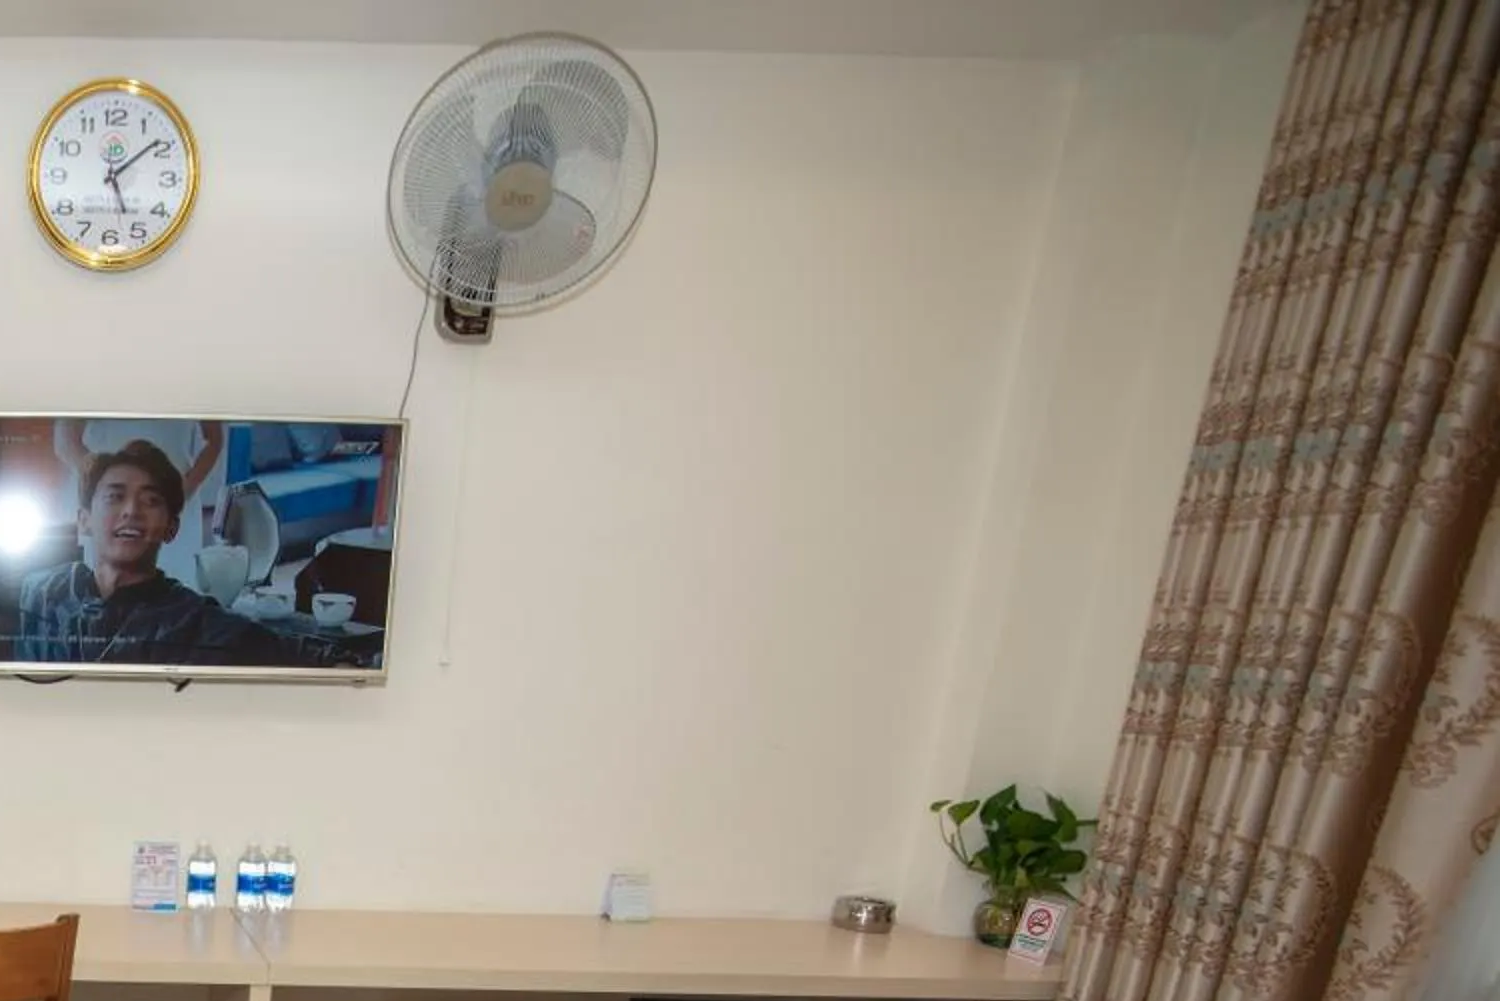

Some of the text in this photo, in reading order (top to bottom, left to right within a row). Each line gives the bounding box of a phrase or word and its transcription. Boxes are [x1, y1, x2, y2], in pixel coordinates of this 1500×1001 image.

[81, 116, 95, 134] 11
[104, 109, 128, 127] 12
[140, 117, 147, 135] 1
[59, 139, 81, 157] 10
[152, 140, 171, 159] 2
[50, 167, 68, 185] 9
[158, 170, 177, 188] 3
[56, 199, 74, 216] 8
[150, 201, 167, 218] 4
[76, 221, 92, 238] 7
[101, 229, 119, 245] 6
[130, 222, 147, 239] 5
